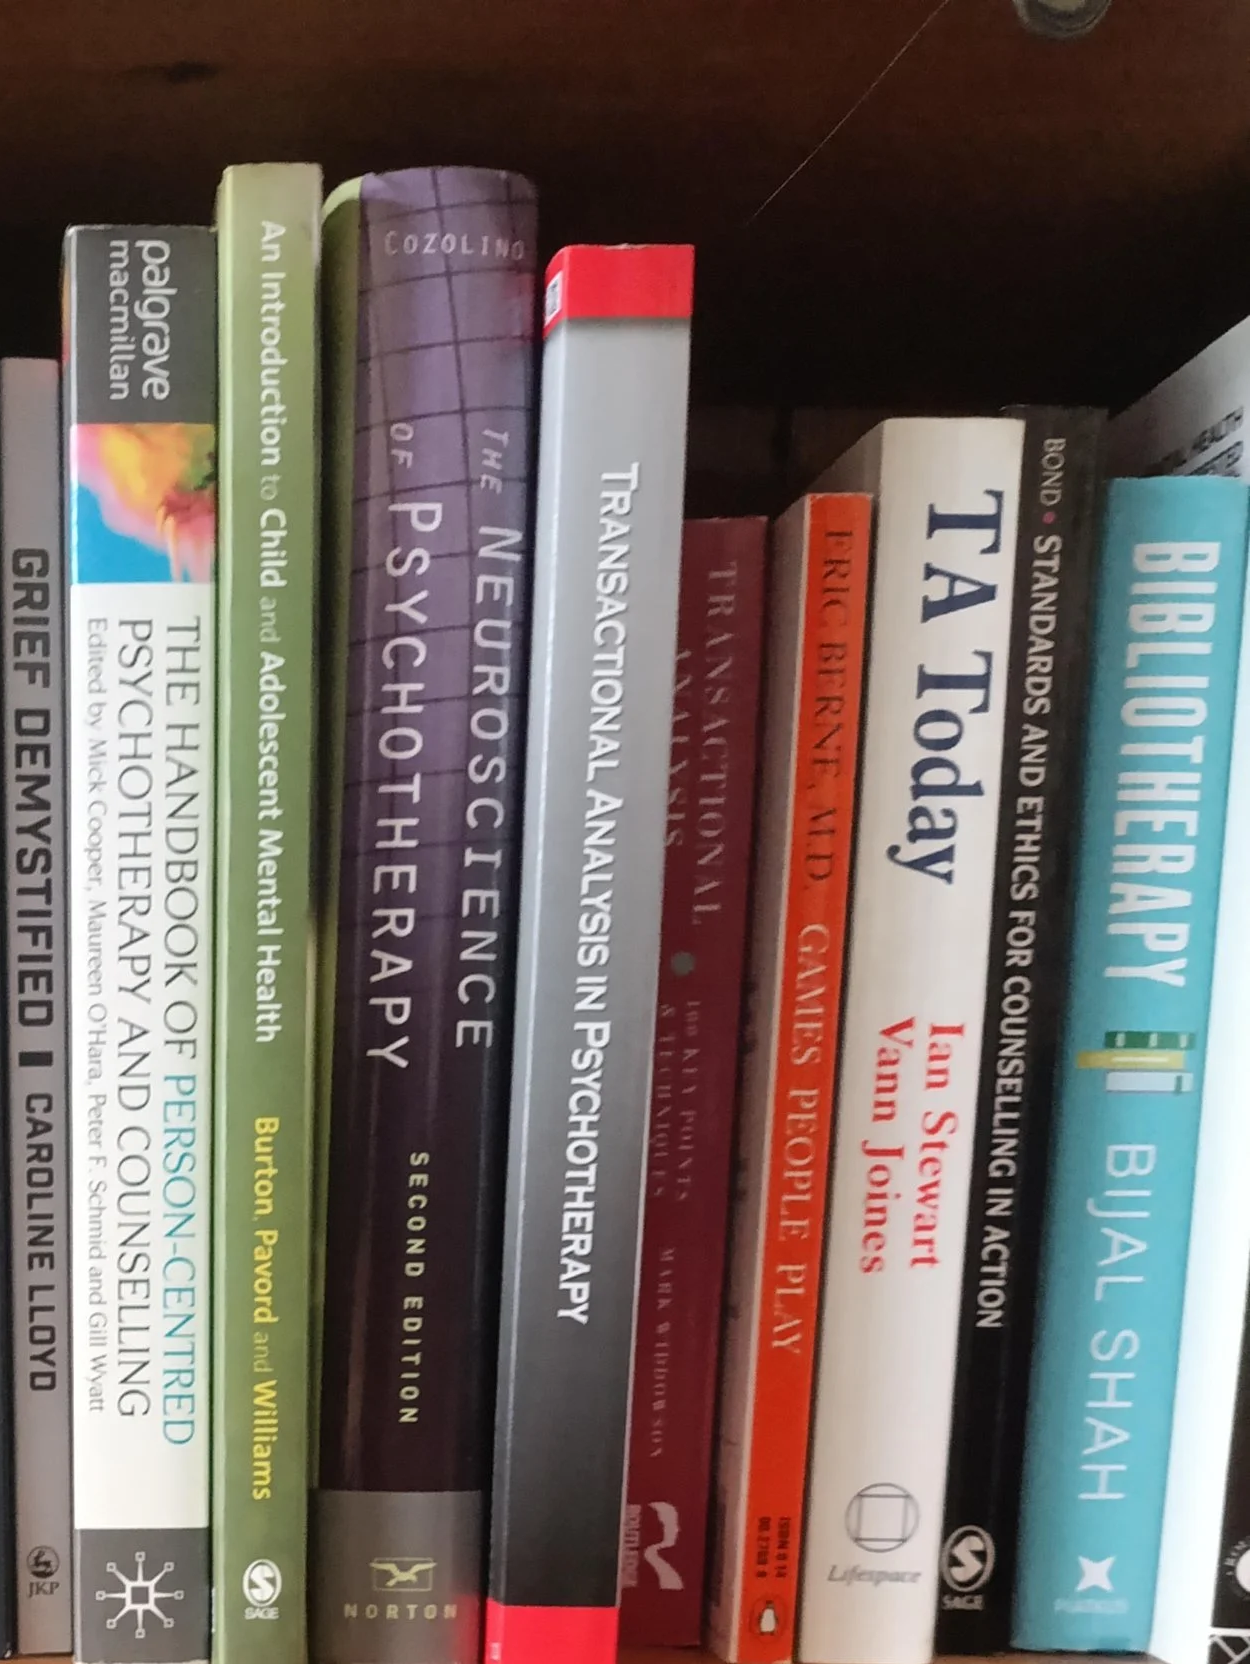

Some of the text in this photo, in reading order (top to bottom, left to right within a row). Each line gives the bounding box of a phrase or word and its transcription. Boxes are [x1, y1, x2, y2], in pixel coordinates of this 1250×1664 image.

[109, 240, 136, 400] macmillan
[134, 239, 178, 401] palgrave
[384, 230, 526, 261] COZOLINO
[256, 220, 289, 1044] An Introduction to Child and Adolescent Mental Health
[1104, 541, 1222, 988] BIBLIOTHERAPY
[11, 547, 58, 1392] GRIEF DEMYSTIFIED CAROLINE LLOYD
[116, 618, 154, 1417] PSYCHOTHERAPY AND COUNSELLING
[162, 615, 201, 1446] THE HANDBOOK OF PERSON-CENTRED
[557, 462, 640, 1326] TRANSACTIONAL ANALYSIS IN PSYCHOTHERAPY
[976, 437, 1066, 1328] BOND STANDARDS AND ETHICS FOR COUNSELLING IN ACTION
[398, 1151, 429, 1424] SECOND EDITION
[859, 1016, 916, 1274] Vann Joines
[909, 1022, 965, 1269] Ian Stewart
[1077, 1143, 1156, 1501] BIJAL SHAH
[344, 1603, 459, 1620] NORTON
[827, 1564, 922, 1587] Lifespace
